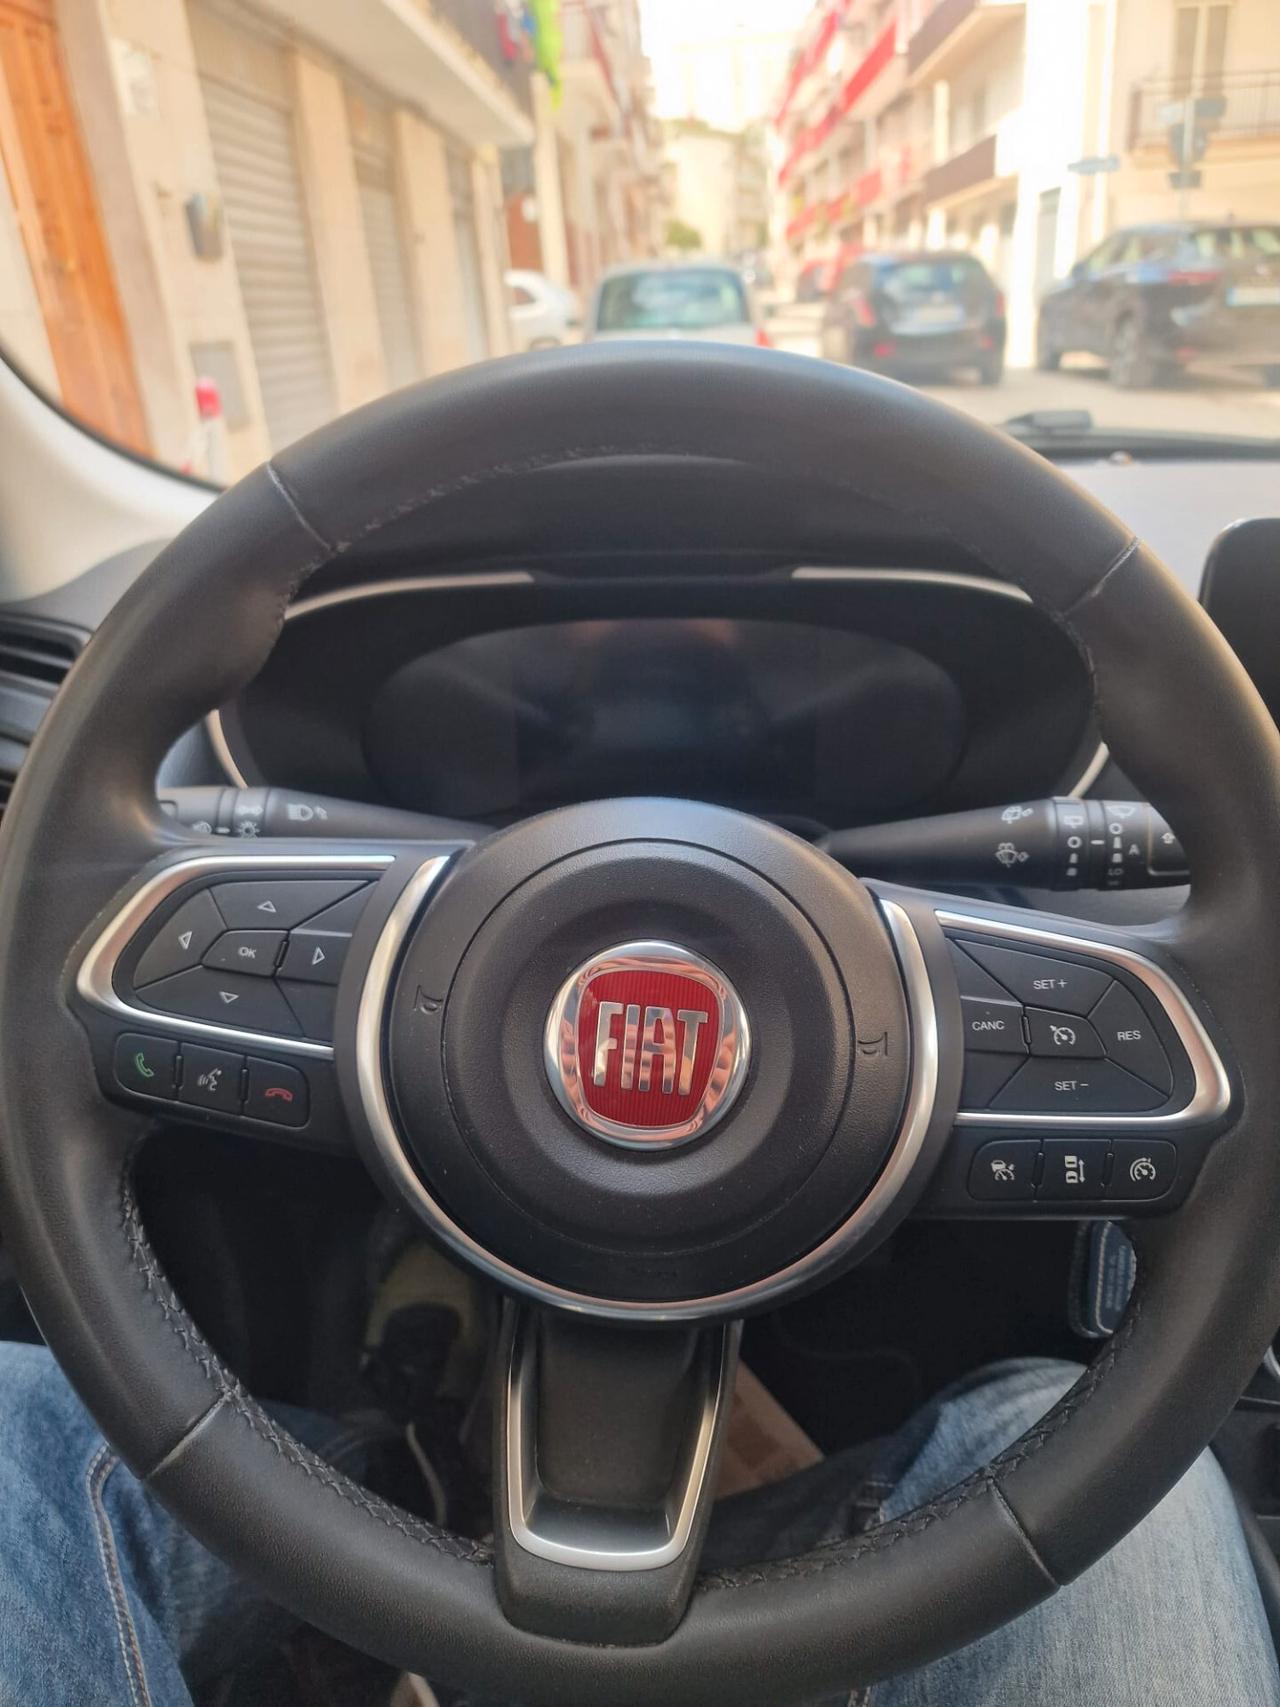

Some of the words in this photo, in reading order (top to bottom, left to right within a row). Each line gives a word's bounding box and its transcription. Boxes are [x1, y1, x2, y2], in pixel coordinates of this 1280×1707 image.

[238, 946, 257, 958] OK
[972, 1020, 1005, 1031] CANC
[1117, 1030, 1141, 1041] RES
[594, 1001, 708, 1095] FIAT
